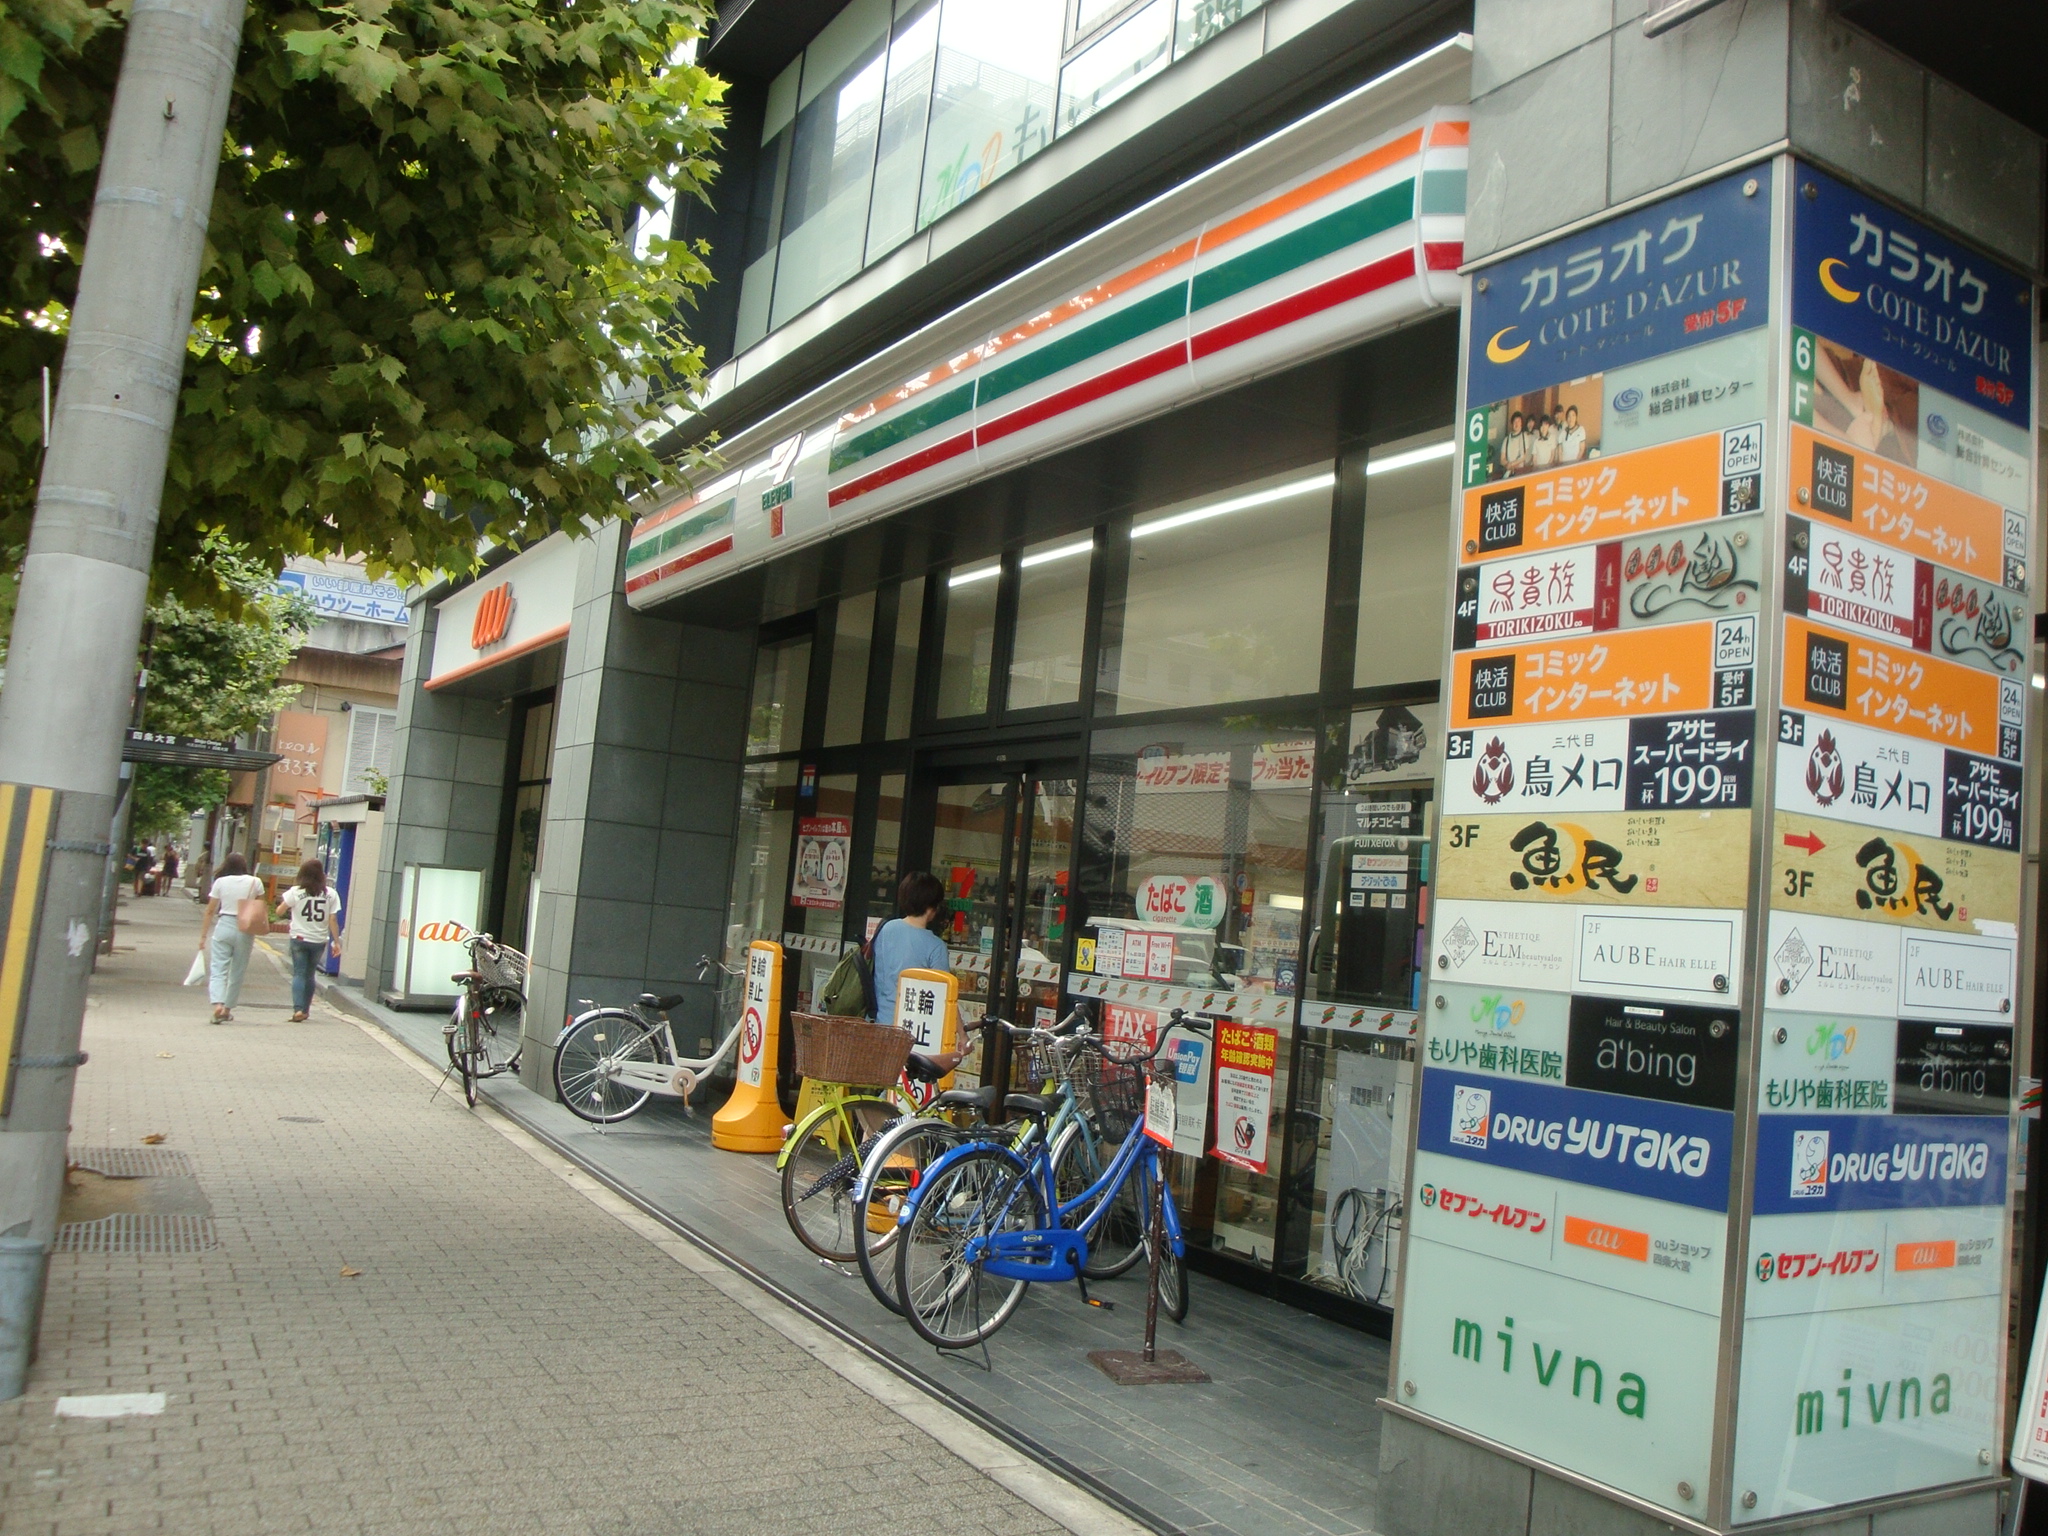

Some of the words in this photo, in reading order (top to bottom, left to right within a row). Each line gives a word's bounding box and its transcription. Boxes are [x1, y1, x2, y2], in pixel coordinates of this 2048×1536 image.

[1520, 214, 1704, 313] カラオケ
[1849, 212, 1989, 315] カラオケ
[1539, 298, 1617, 346] COTE
[1866, 283, 1930, 337] COTE
[1648, 380, 1754, 417] 総合計算センター
[1651, 377, 1691, 397] 株式会社
[1727, 453, 1758, 468] OPEN
[1817, 456, 1848, 488] 快活
[1535, 466, 1618, 507] コミック
[1817, 484, 1848, 508] CLUB
[1862, 463, 1929, 510] コミック
[1485, 498, 1518, 523] 快活
[1534, 486, 1690, 542] インターネット
[1485, 520, 1517, 541] CLUB
[1862, 502, 1978, 564] インターネット
[2006, 536, 2024, 550] OPEN
[1788, 556, 1809, 576] 4F
[472, 581, 513, 650] au
[1458, 599, 1476, 617] 4F
[1818, 593, 1895, 632] TORIKIZOKU
[1488, 611, 1575, 638] TORIKIZOKU
[1524, 644, 1609, 679] コミック
[1719, 646, 1751, 660] OPEN
[1811, 646, 1842, 677] 快活
[1475, 666, 1509, 690] 快活
[1722, 671, 1745, 685] 受付
[1856, 647, 1924, 691] コミック
[1523, 673, 1681, 714] インターネット
[1721, 686, 1745, 707] 5F
[1811, 674, 1841, 697] CLUB
[1475, 691, 1507, 708] CLUB
[2003, 705, 2021, 719] OPEN
[1856, 687, 1973, 741] インターネット
[132, 731, 176, 745] 四条大宮
[1552, 733, 1595, 749] 三代目
[1667, 720, 1716, 740] アサヒ
[1780, 715, 1803, 742] 3F
[1450, 735, 1471, 757] 3F
[1634, 740, 1750, 766] スーパードライ
[1876, 746, 1910, 765] 三代目
[2003, 743, 2018, 760] 5F
[1521, 753, 1623, 798] 鳥メロ
[1969, 760, 2000, 785] アサヒ
[1850, 760, 1931, 815] 鳥メロ
[1947, 776, 2020, 810] スーパードライ
[1356, 816, 1410, 828] マルチコピー機
[1449, 824, 1481, 848] 3F
[1510, 820, 1638, 894] 魚民
[1784, 868, 1815, 898] 3F
[1855, 836, 1955, 922] 魚民
[1146, 882, 1187, 914] たばこ
[1194, 884, 1214, 915] 酒
[301, 900, 326, 922] 45
[1152, 915, 1177, 924] cigarette
[418, 922, 470, 942] au
[1588, 922, 1601, 934] 2F
[1151, 940, 1161, 948] Free
[1911, 946, 1920, 957] 2F
[1593, 944, 1657, 967] AUBE
[1658, 957, 1687, 970] HAIR
[1690, 958, 1717, 971] ELLE
[1915, 967, 1965, 991] AUBE
[1965, 981, 1984, 993] HAIR
[1986, 982, 2004, 994] ELLE
[904, 987, 935, 1016] 駐輪
[1605, 1016, 1623, 1028] Hair
[1625, 1018, 1632, 1029] &
[1634, 1019, 1667, 1035] Beauty
[1670, 1022, 1696, 1036] Salon
[1168, 1048, 1201, 1068] UnionPay
[1427, 1036, 1564, 1079] もりや歯科医院
[1766, 1078, 1889, 1110] もりや歯科医院
[1465, 1135, 1485, 1147] ユタカ
[1492, 1112, 1563, 1151] DRUG
[1829, 1152, 1890, 1184] DRUG
[1804, 1183, 1825, 1196] ユタカ
[1586, 1226, 1624, 1250] au
[1654, 1238, 1712, 1259] auショップ
[1653, 1253, 1692, 1273] 四条大宮
[1912, 1246, 1938, 1266] au
[1452, 1316, 1647, 1420] mivna
[1796, 1368, 1952, 1436] mivna
